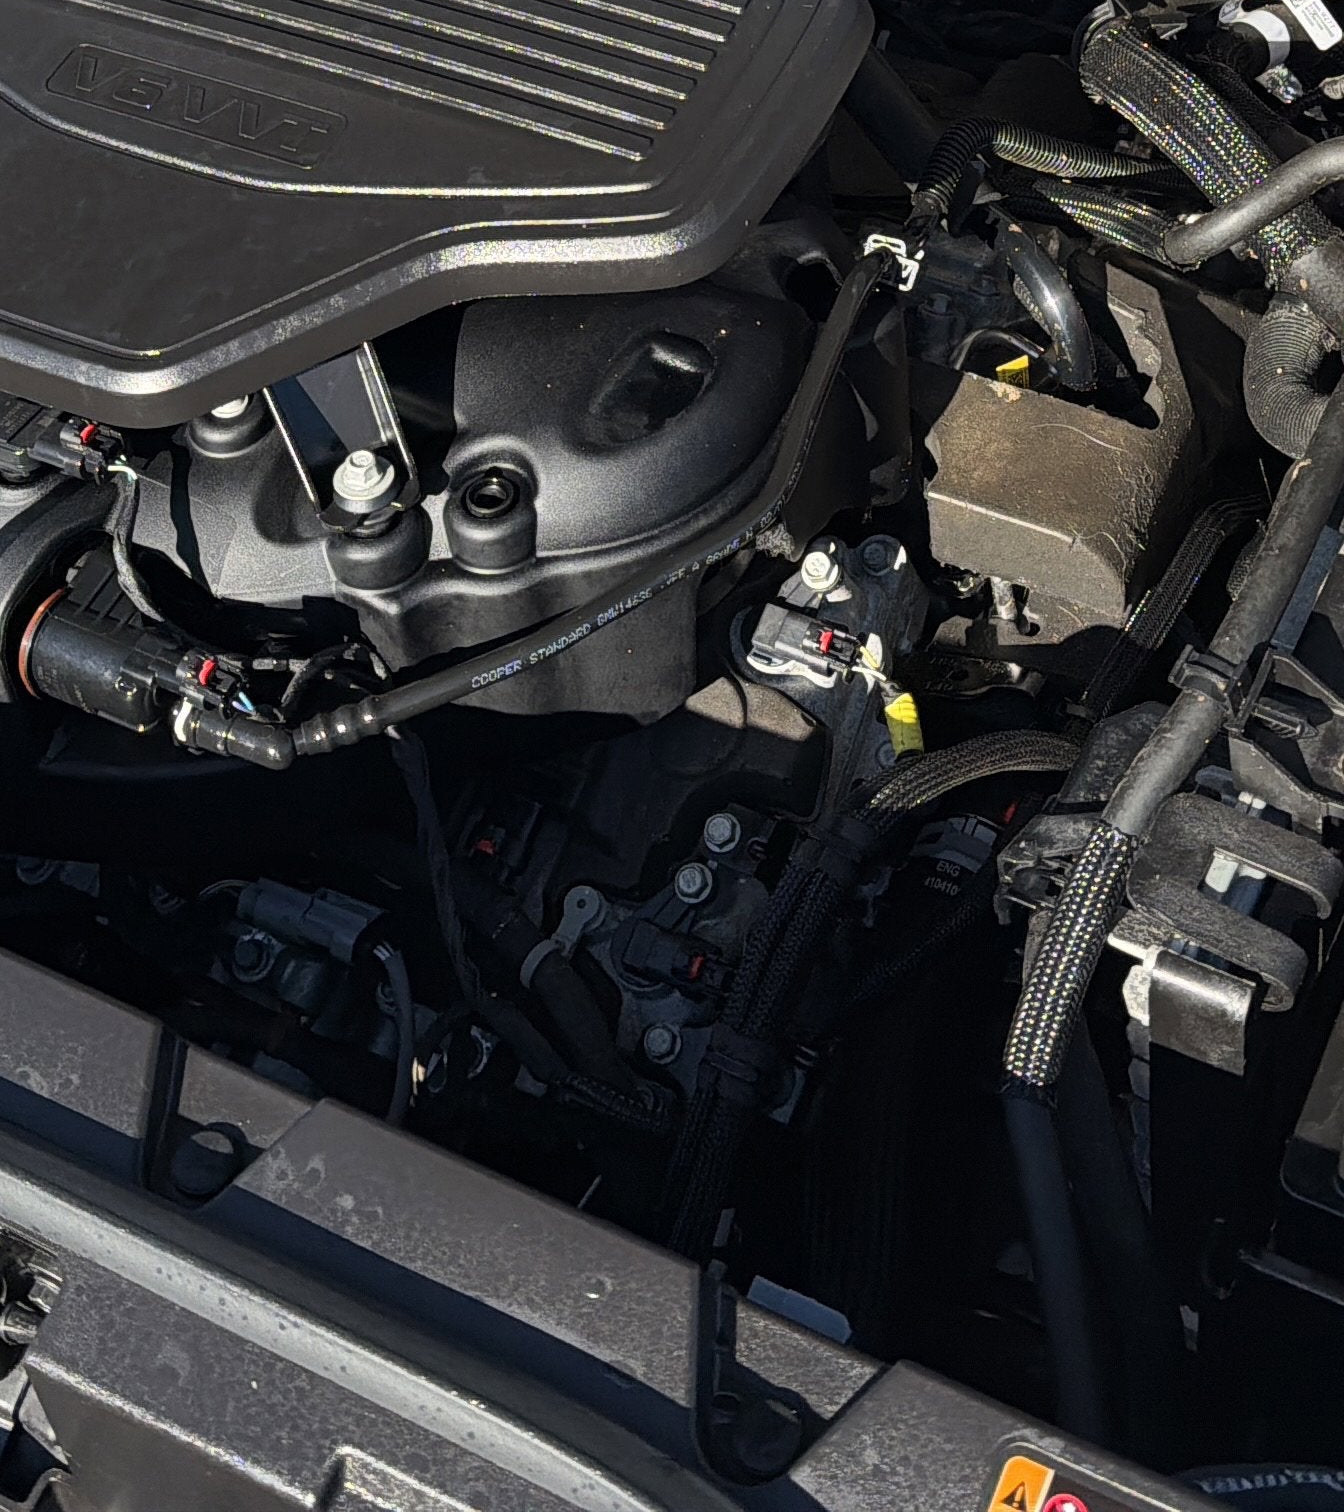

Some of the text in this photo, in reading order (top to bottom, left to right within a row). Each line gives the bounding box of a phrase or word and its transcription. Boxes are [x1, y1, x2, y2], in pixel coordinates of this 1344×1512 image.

[72, 52, 329, 155] V6 VVT
[468, 655, 524, 691] COOPER
[526, 623, 594, 663] STANDARD
[936, 859, 962, 878] ENG
